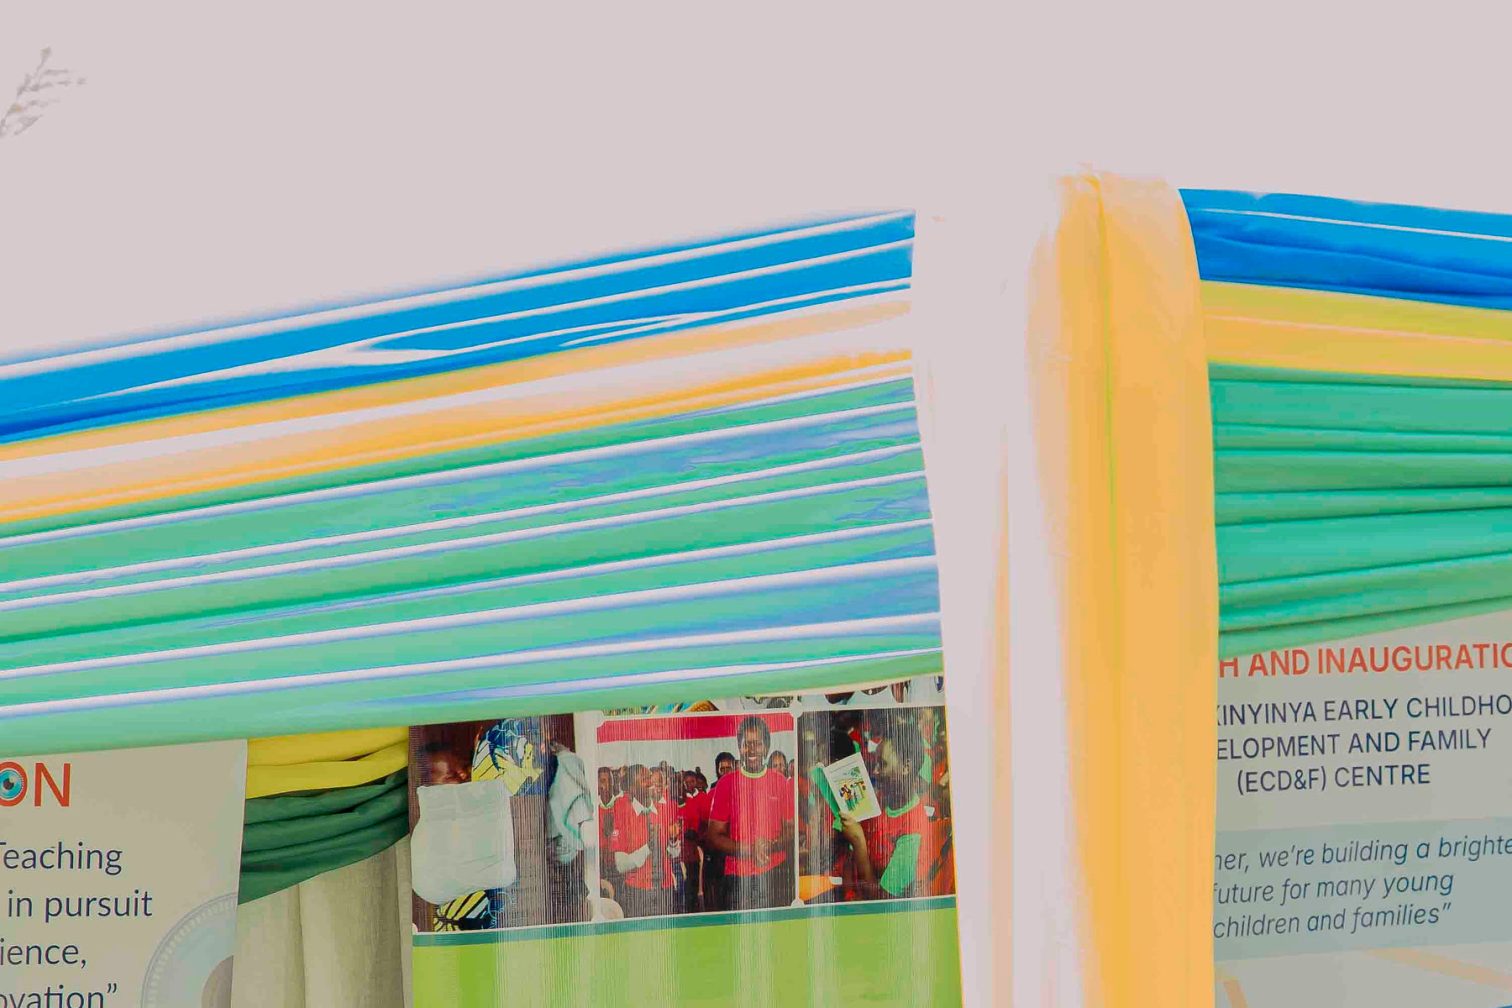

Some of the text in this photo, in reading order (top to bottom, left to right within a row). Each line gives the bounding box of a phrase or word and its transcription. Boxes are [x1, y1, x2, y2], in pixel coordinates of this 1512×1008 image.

[1248, 649, 1309, 677] AND
[1324, 698, 1398, 721] EARLY
[1217, 728, 1492, 760] ELOPMENT AND FAMILY
[0, 761, 71, 807] ON
[1237, 764, 1431, 795] (ECD&F) CENTRE
[0, 841, 123, 876] eaching
[1259, 844, 1315, 868] we're
[1321, 840, 1408, 866] building
[1416, 840, 1430, 858] a
[1280, 879, 1311, 906] for
[1316, 876, 1376, 901] many
[1382, 872, 1454, 898] young
[8, 889, 152, 923] in pursuit
[1212, 914, 1300, 939] children
[1307, 909, 1346, 932] and
